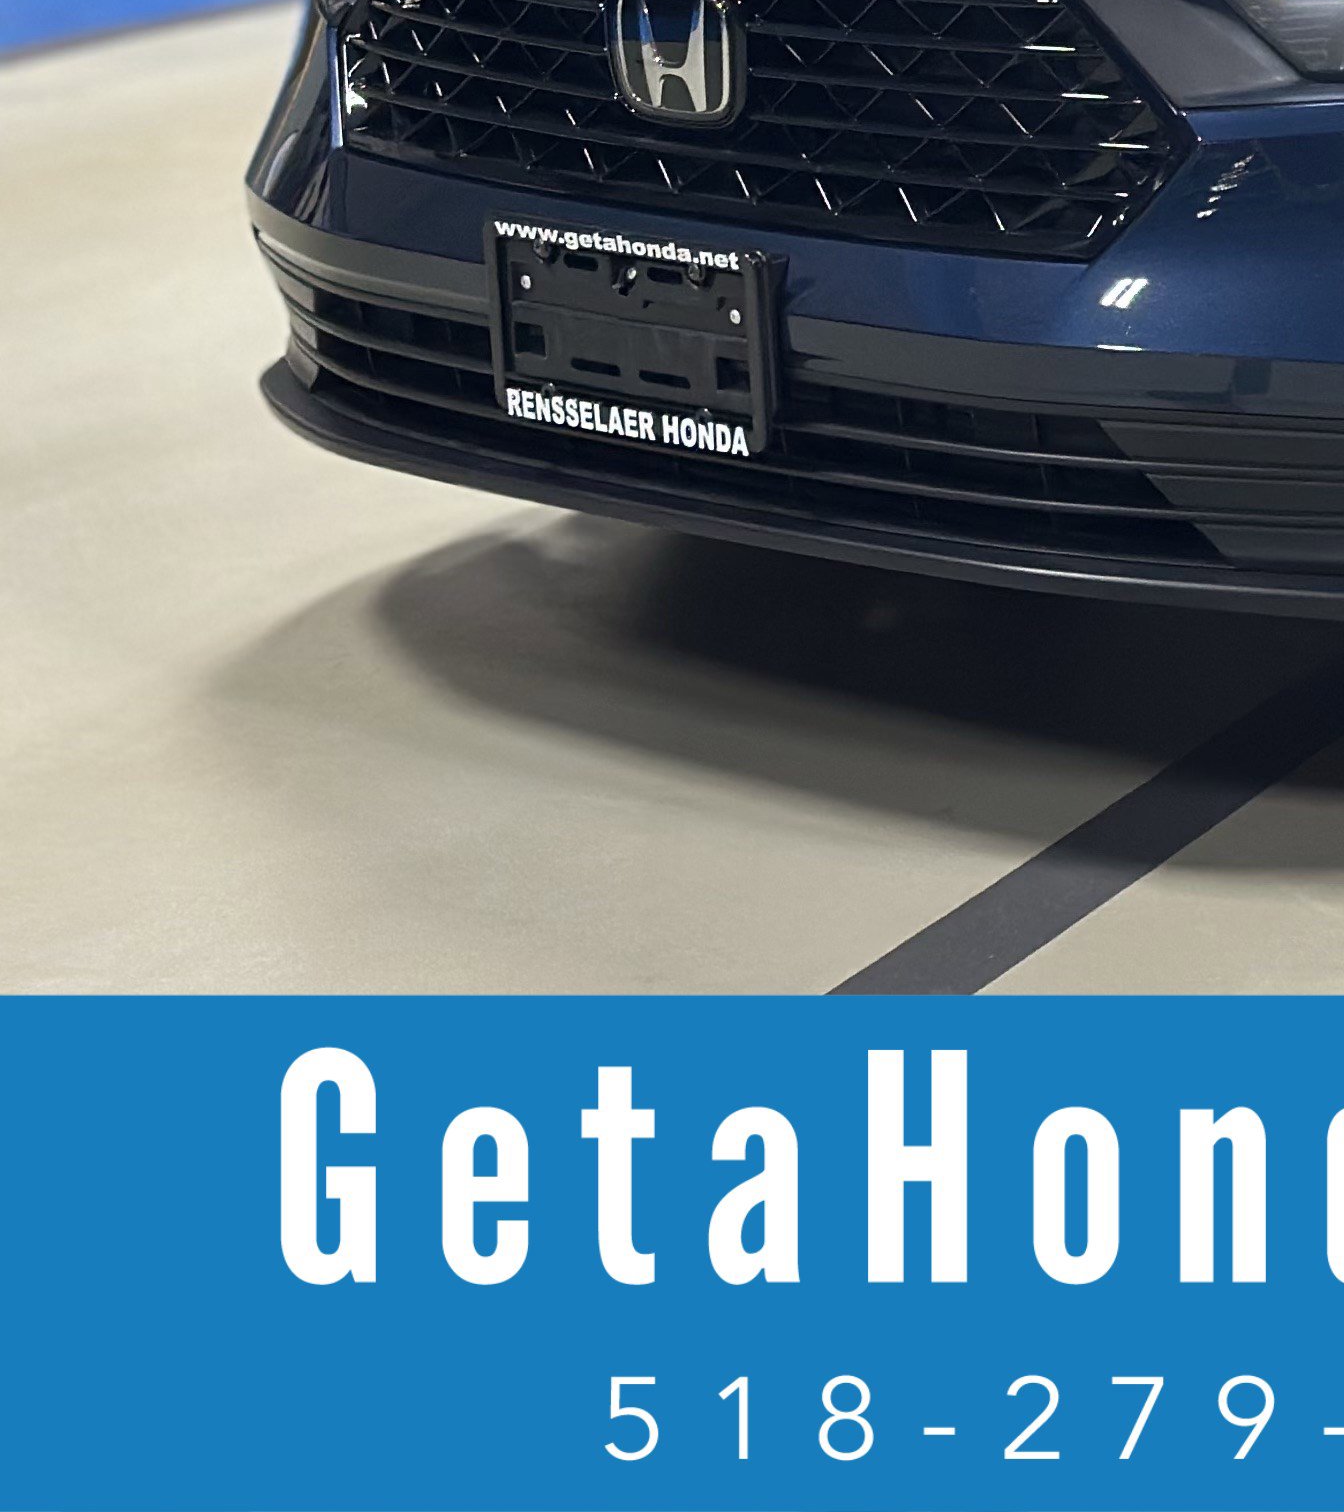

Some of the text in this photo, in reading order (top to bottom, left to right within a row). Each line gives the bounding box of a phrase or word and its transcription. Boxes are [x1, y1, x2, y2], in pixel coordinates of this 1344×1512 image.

[494, 220, 740, 270] www.getahonda.net
[506, 388, 750, 457] RENSSELAER HONDA
